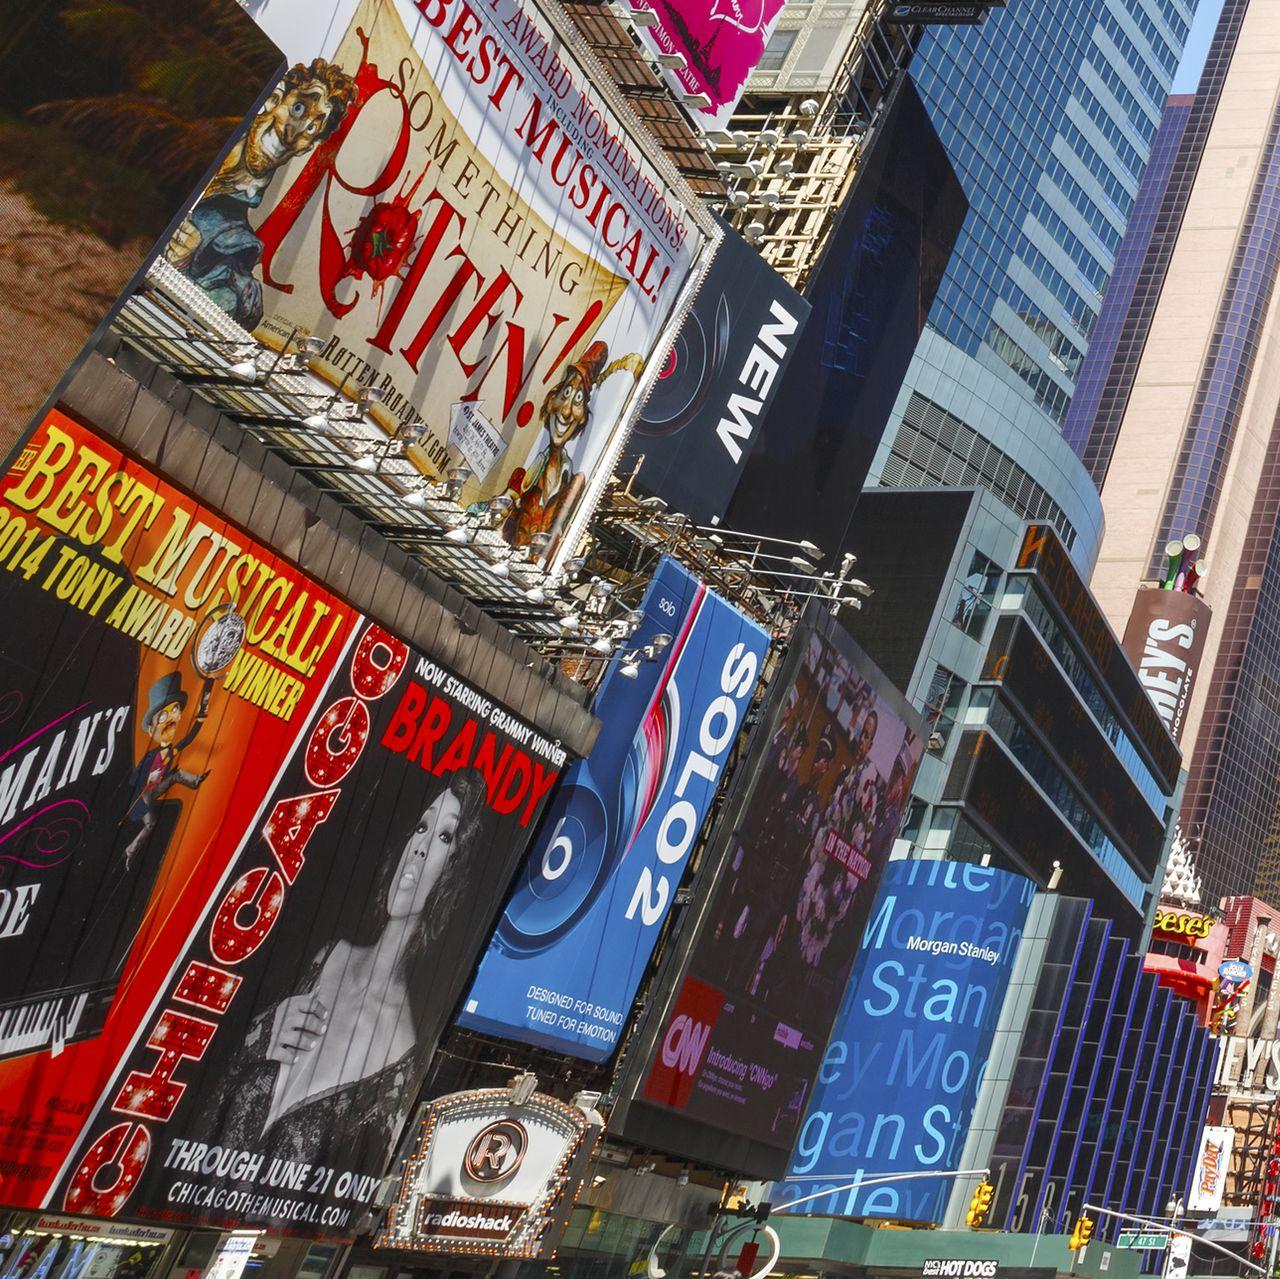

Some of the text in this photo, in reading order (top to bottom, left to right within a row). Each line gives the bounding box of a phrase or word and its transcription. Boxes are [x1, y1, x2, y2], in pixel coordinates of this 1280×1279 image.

[505, 10, 573, 100] AWARD
[571, 91, 688, 252] NOMINATIONS!
[546, 95, 594, 160] INCLUDING
[389, 58, 583, 294] SOMETHING
[515, 93, 670, 303] MUSICAL!
[716, 299, 798, 464] NEW
[3, 425, 343, 679] BEST MUSICAL!
[41, 546, 306, 722] TONY AWARD WINNER
[658, 596, 676, 617] solo
[415, 657, 567, 767] NOW STARRING GRAMMY WINNER
[1172, 667, 1194, 741] HOCOLATE
[381, 680, 559, 828] BRANDY
[62, 622, 409, 1217] CHICAGO
[906, 936, 1000, 966] Morgan Stanley
[525, 1006, 617, 1044] TUNED FOR EMOTION.
[526, 985, 624, 1026] DESIGNED FOR SOUND.
[662, 1014, 712, 1076] CNN
[707, 1046, 748, 1081] Introducing
[164, 1138, 381, 1204] THROUGH JUNE 21 ONLY
[167, 1181, 351, 1227] CHICAGOTHEMUSICAL.COM
[424, 1211, 513, 1232] radioshack
[941, 1260, 997, 1277] HOT DOGS
[1137, 1236, 1147, 1246] 47
